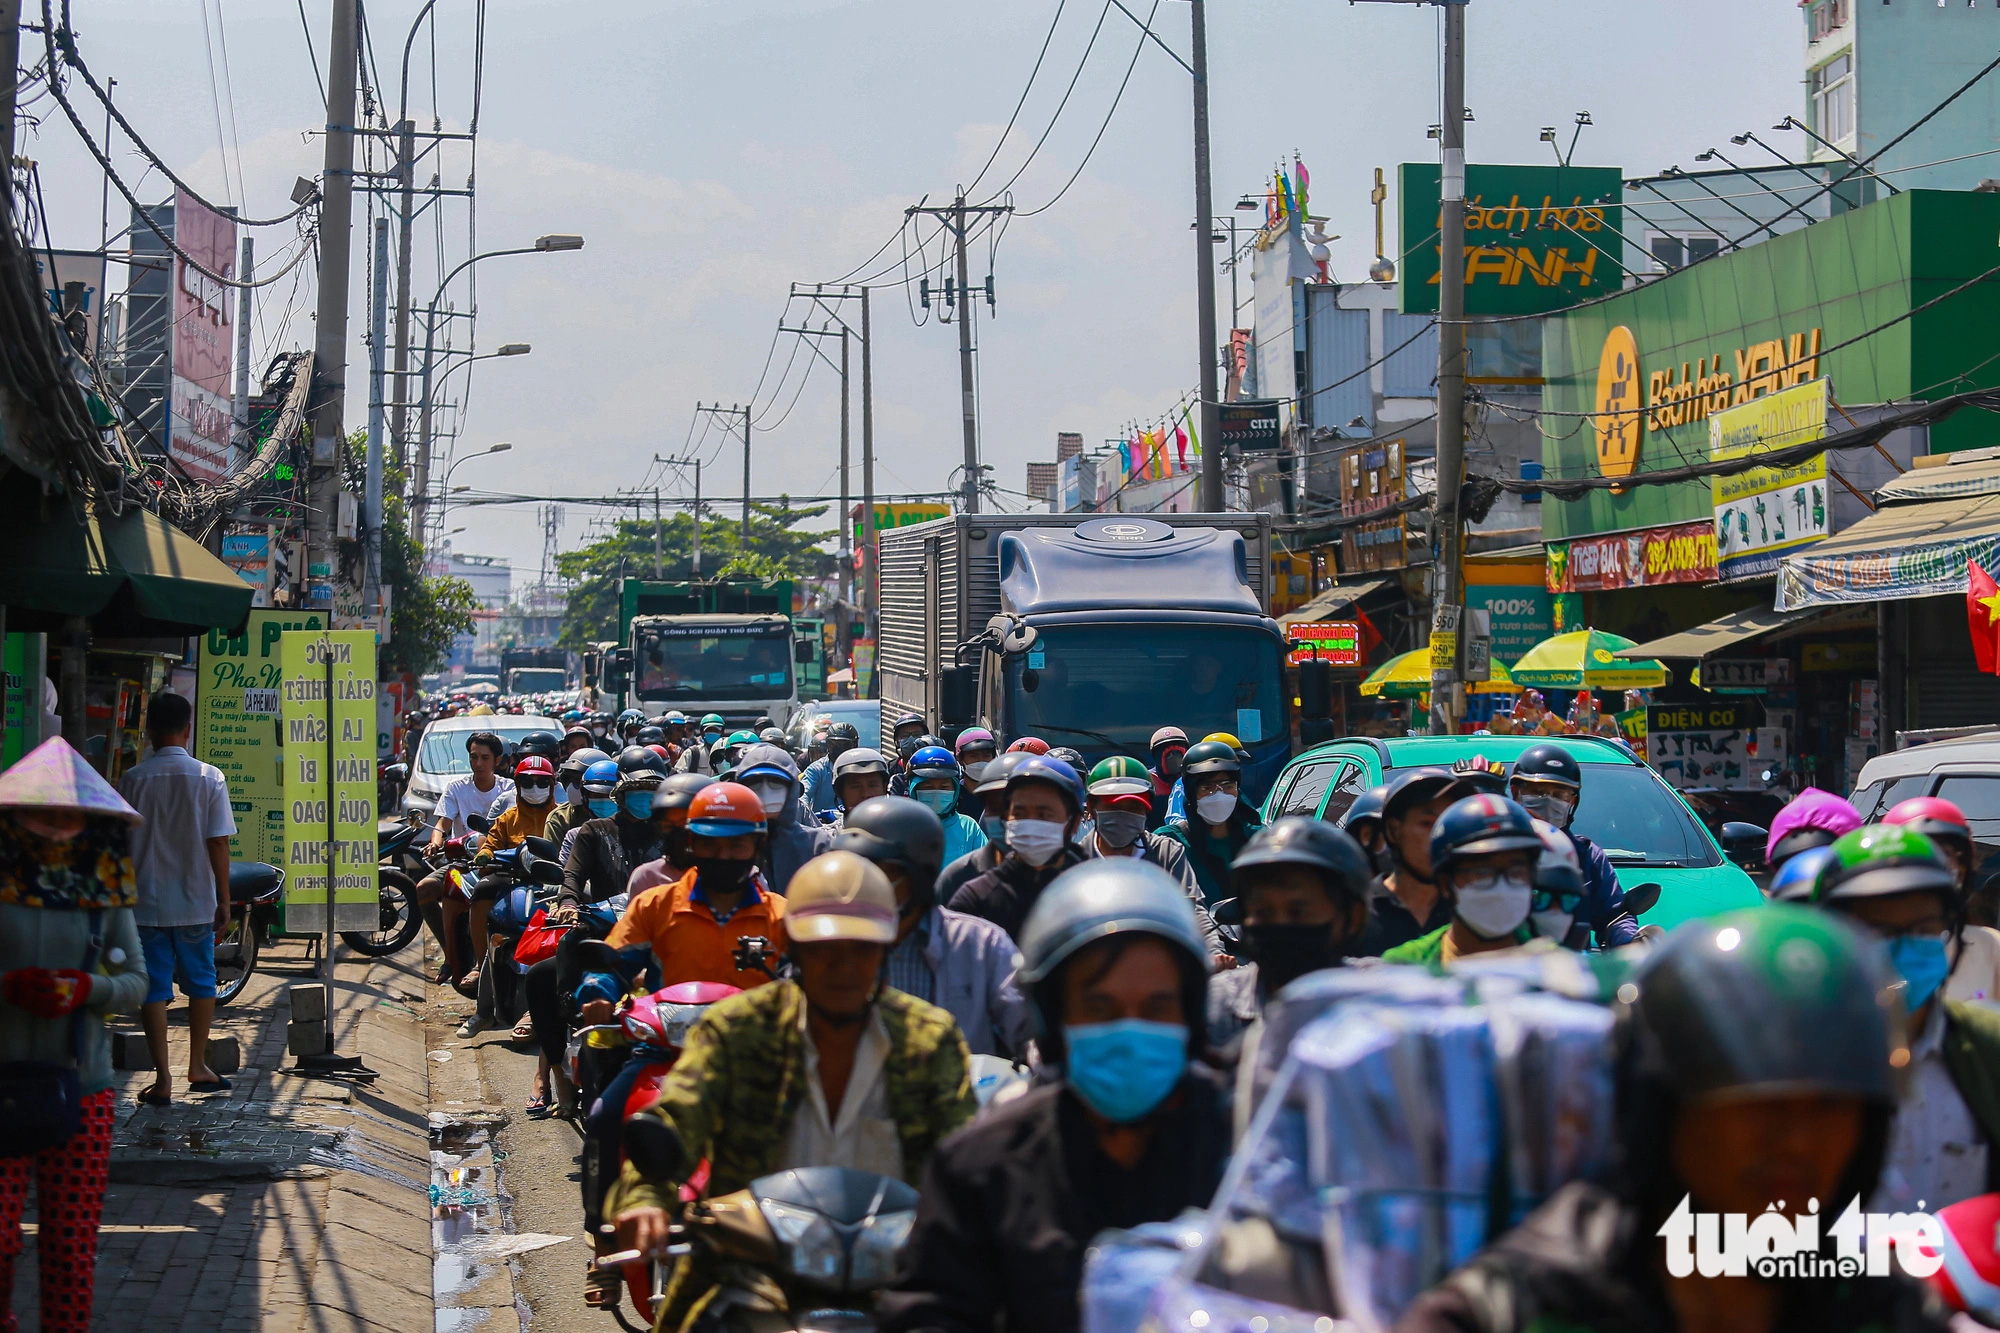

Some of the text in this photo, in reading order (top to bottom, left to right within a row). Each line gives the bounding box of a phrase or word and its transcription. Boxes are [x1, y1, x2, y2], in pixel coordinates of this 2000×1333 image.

[1436, 195, 1605, 231] ách hóa
[1648, 328, 1821, 432] Bách hóa XANH
[1250, 418, 1277, 429] CITY
[1573, 546, 1598, 576] TIGER
[1601, 542, 1621, 579] BẠC
[1813, 556, 1847, 592] CLB
[1897, 545, 1948, 585] MINH
[1485, 599, 1536, 615] 100%
[1436, 615, 1454, 629] 950
[1433, 644, 1448, 656] 950
[213, 662, 258, 690] Pha
[211, 699, 237, 709] Cà phê
[211, 711, 223, 720] Pha
[1658, 708, 1736, 730] ĐIỆN CƠ
[210, 724, 219, 732] Cà
[221, 725, 233, 733] phê
[210, 736, 218, 744] Cà
[221, 737, 232, 746] phê
[209, 748, 233, 757] Cacao
[266, 822, 277, 830] Rau
